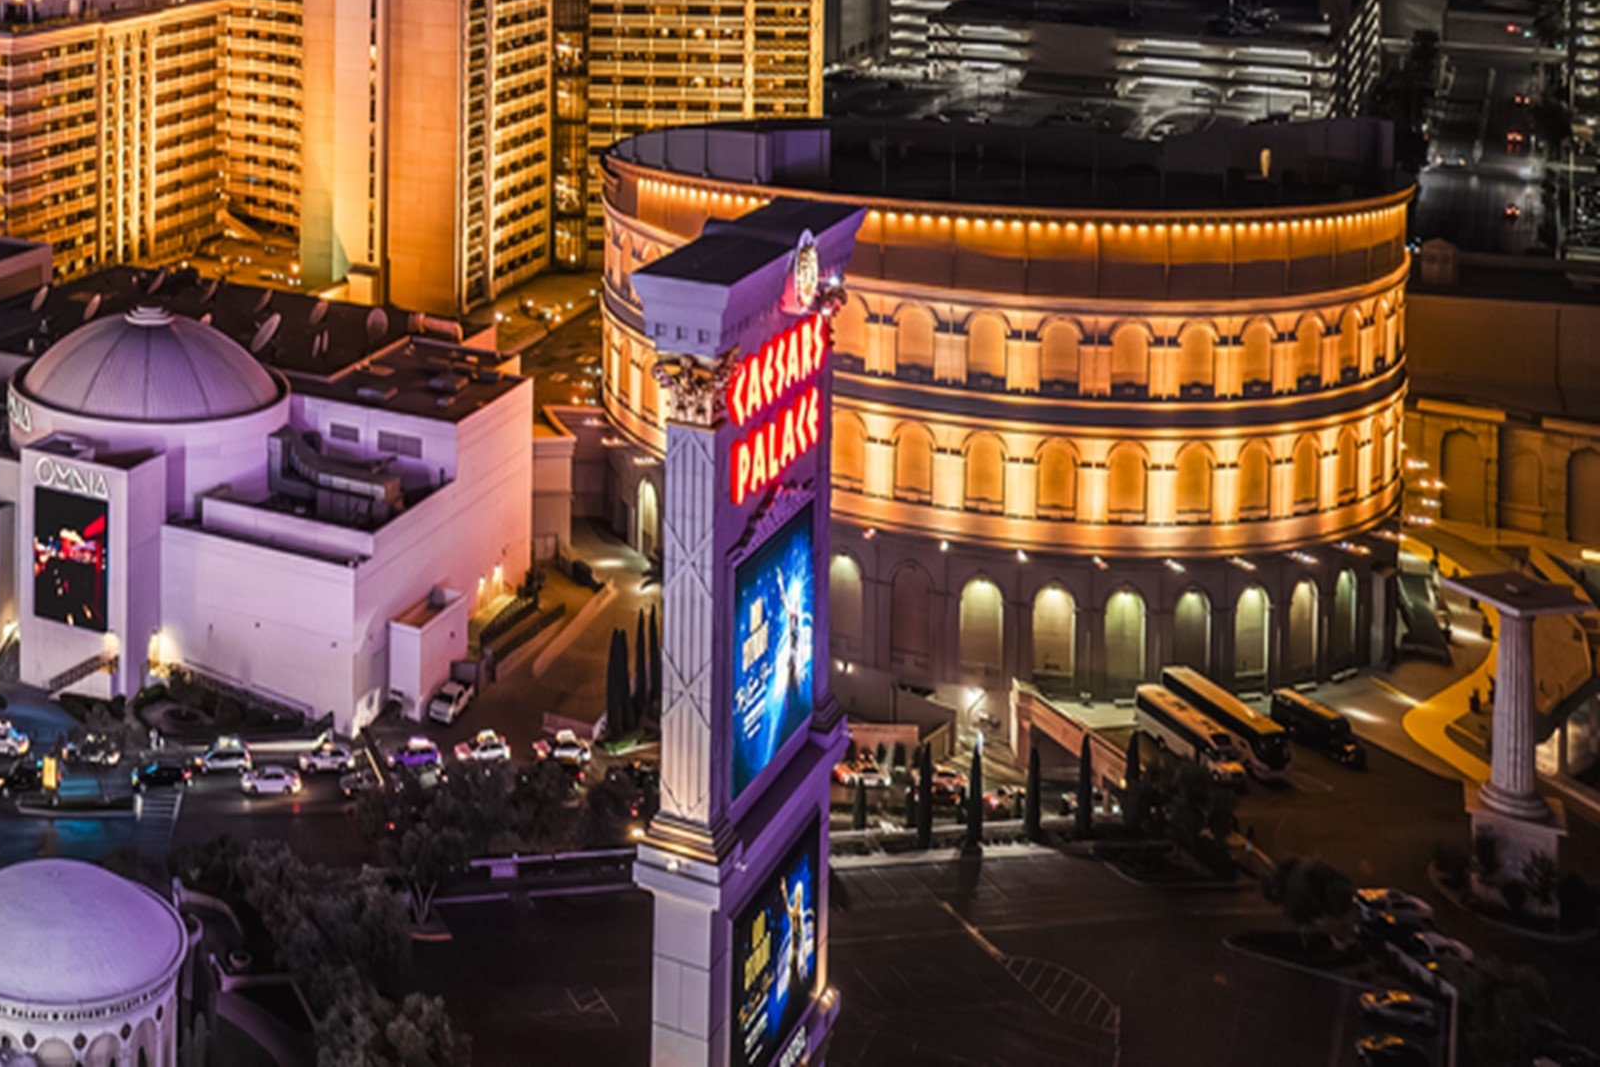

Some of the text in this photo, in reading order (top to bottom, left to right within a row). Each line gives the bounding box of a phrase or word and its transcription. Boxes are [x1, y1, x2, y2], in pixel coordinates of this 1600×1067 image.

[731, 312, 825, 427] CAESARS
[35, 455, 110, 502] OMNIA
[735, 386, 819, 506] PALACE
